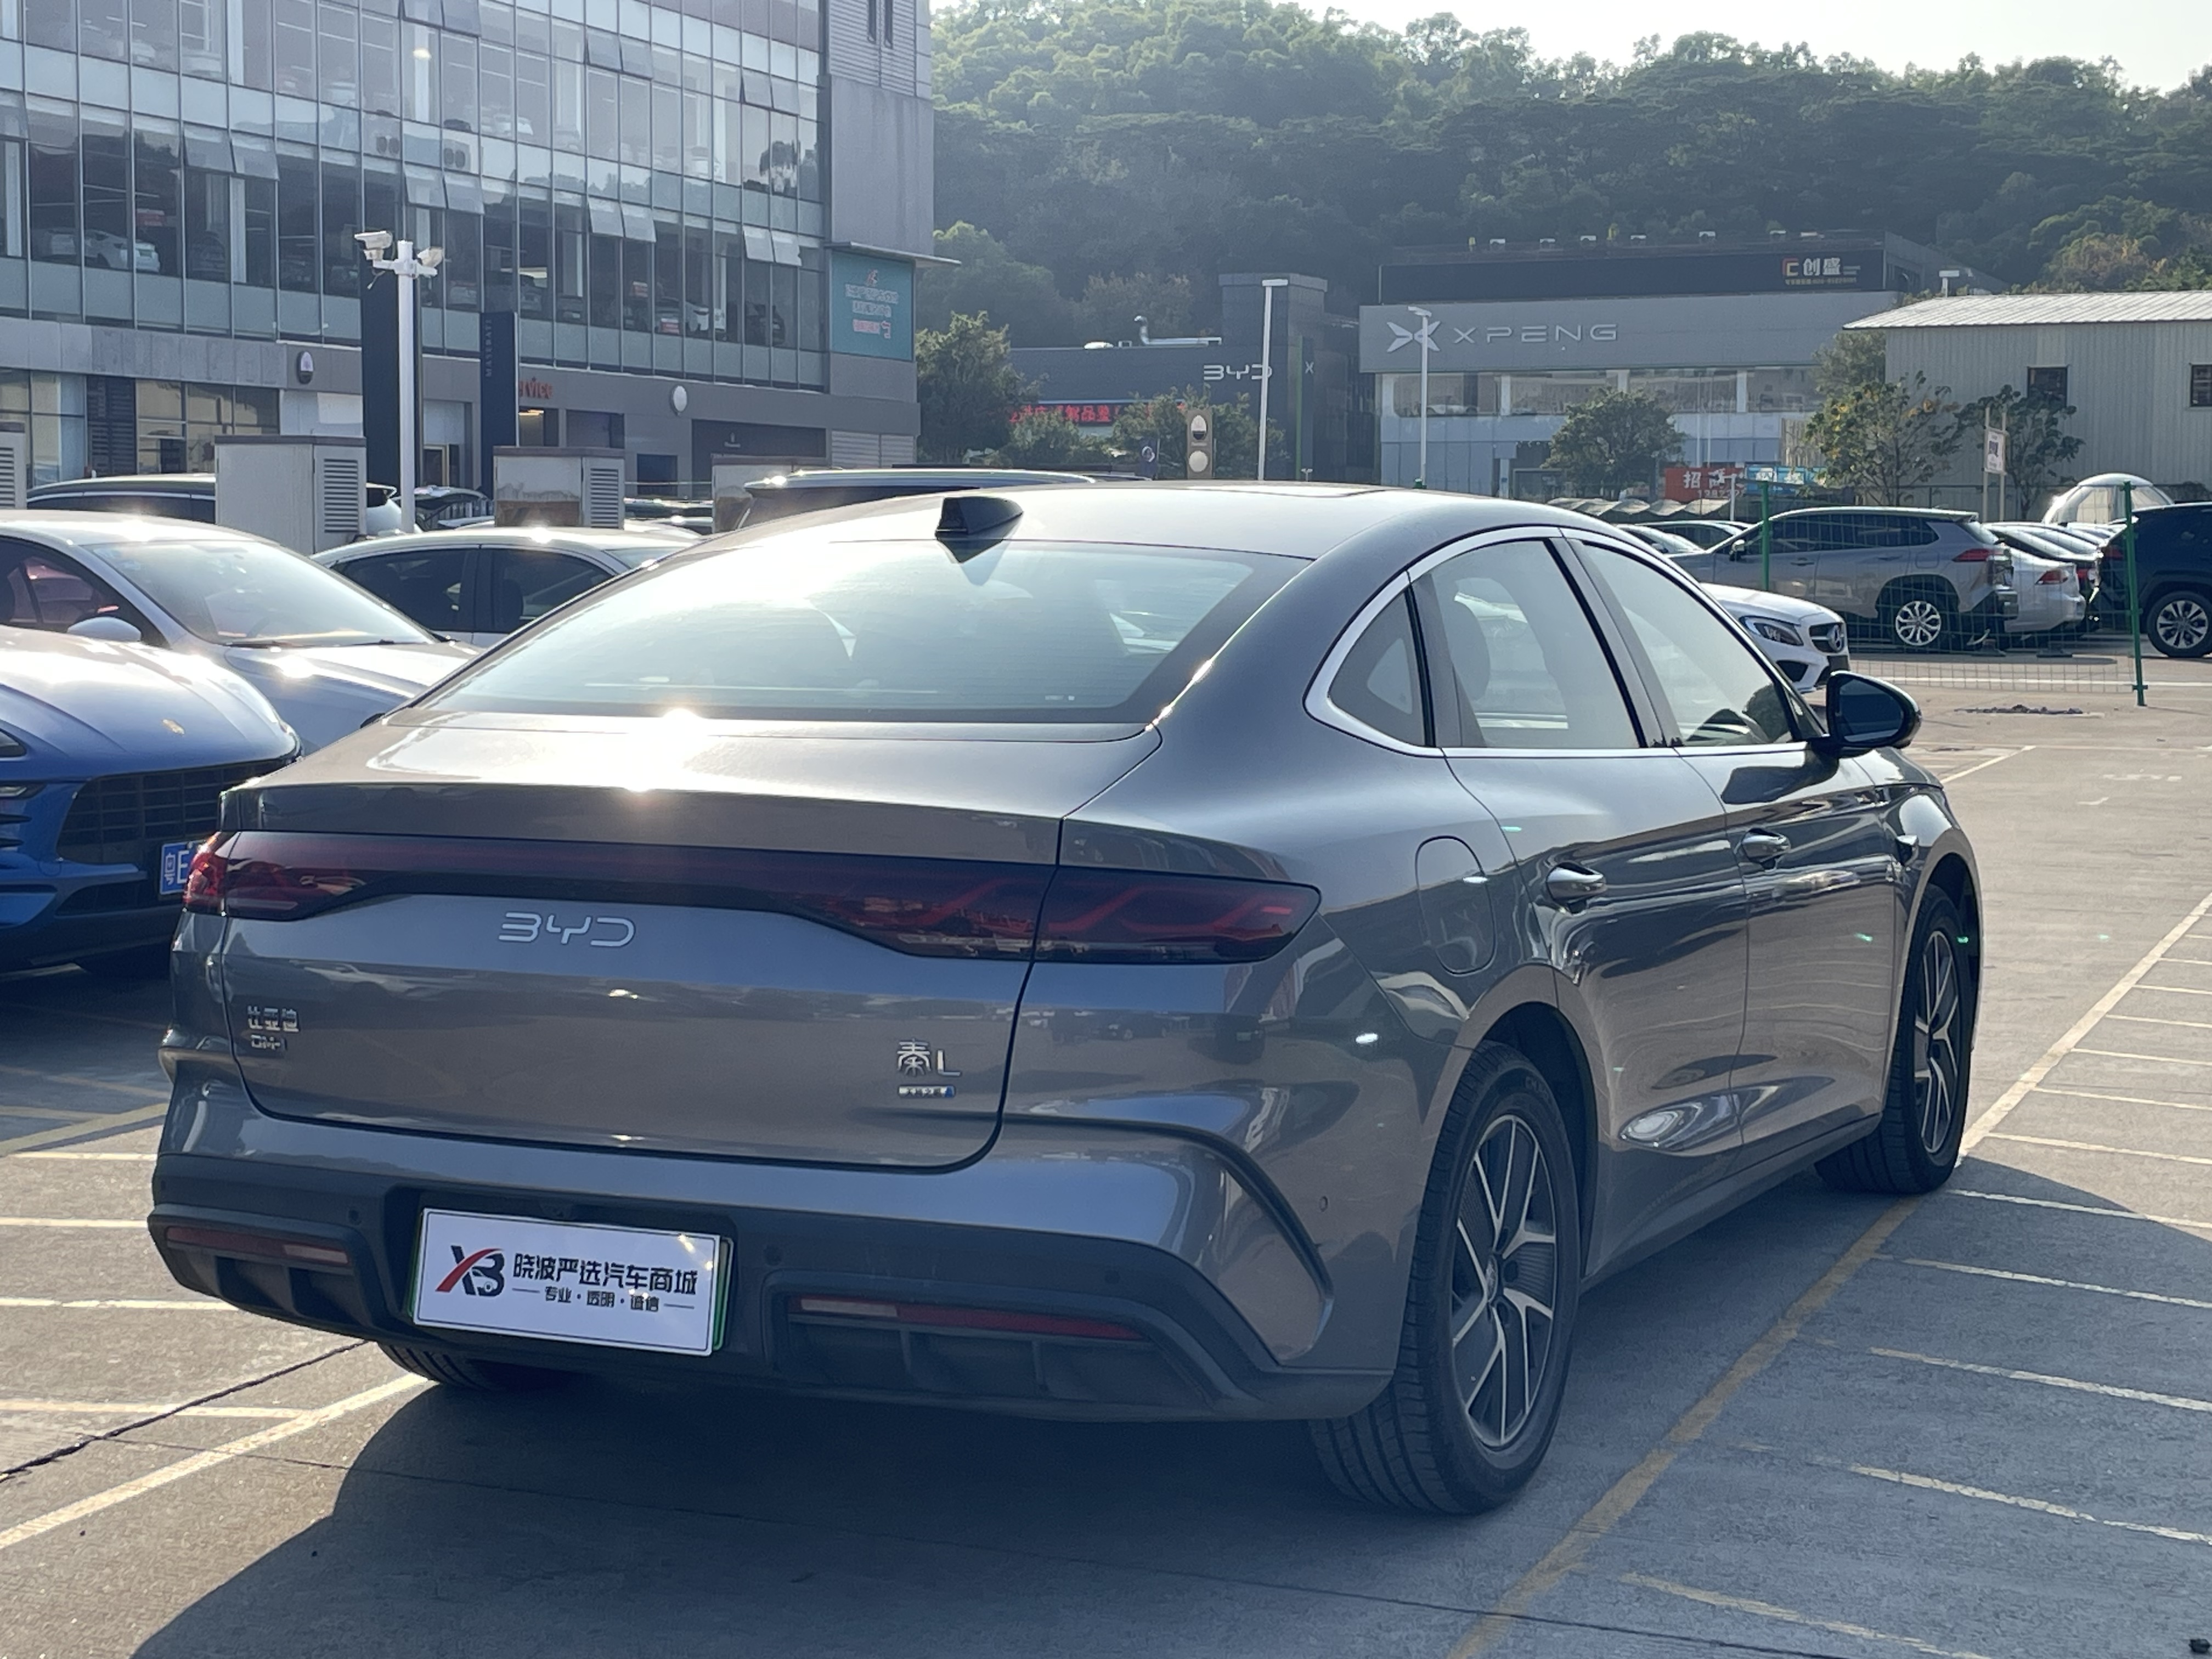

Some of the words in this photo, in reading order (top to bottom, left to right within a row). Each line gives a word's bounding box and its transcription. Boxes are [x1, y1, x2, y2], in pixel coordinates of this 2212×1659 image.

[1803, 258, 1841, 276] 创盛
[1454, 324, 1617, 344] XPENG
[1204, 364, 1272, 380] BYD
[498, 912, 635, 947] BYD
[896, 1038, 961, 1077] 秦L
[513, 1253, 698, 1295] 晓波严选汽车商城
